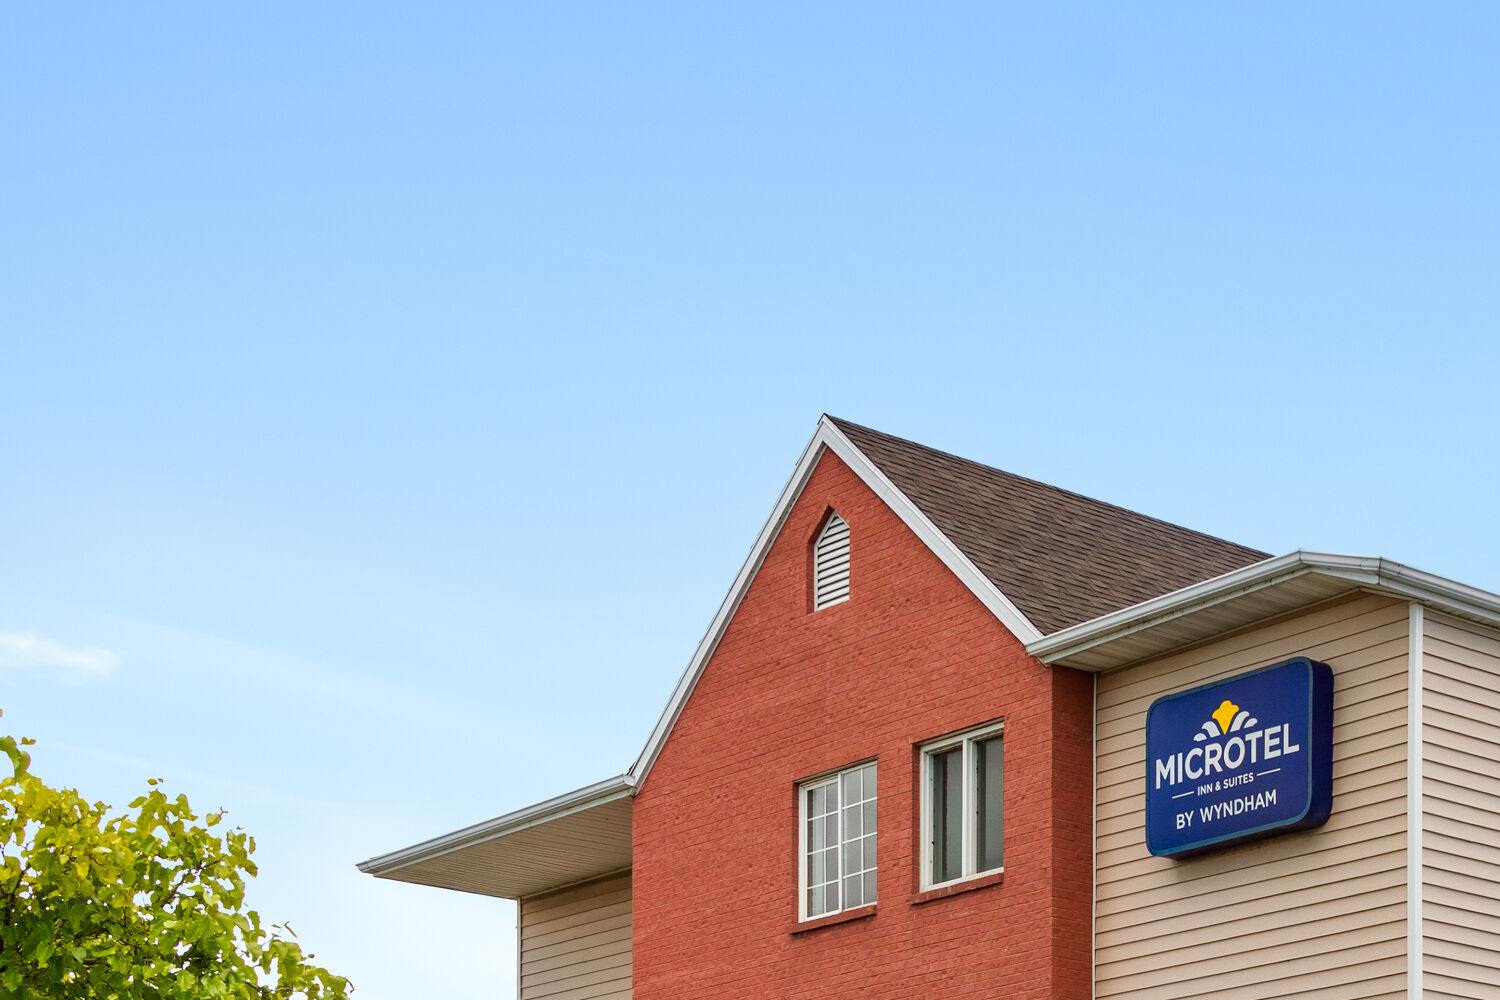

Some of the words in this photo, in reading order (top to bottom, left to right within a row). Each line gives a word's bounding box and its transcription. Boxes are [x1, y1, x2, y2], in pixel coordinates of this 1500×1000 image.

[1155, 723, 1300, 790] MICROTEL
[1197, 783, 1213, 796] INN
[1215, 781, 1221, 791] &
[1223, 772, 1254, 789] SUITES
[1176, 811, 1194, 830] BY
[1200, 789, 1277, 823] WYNDHAM
